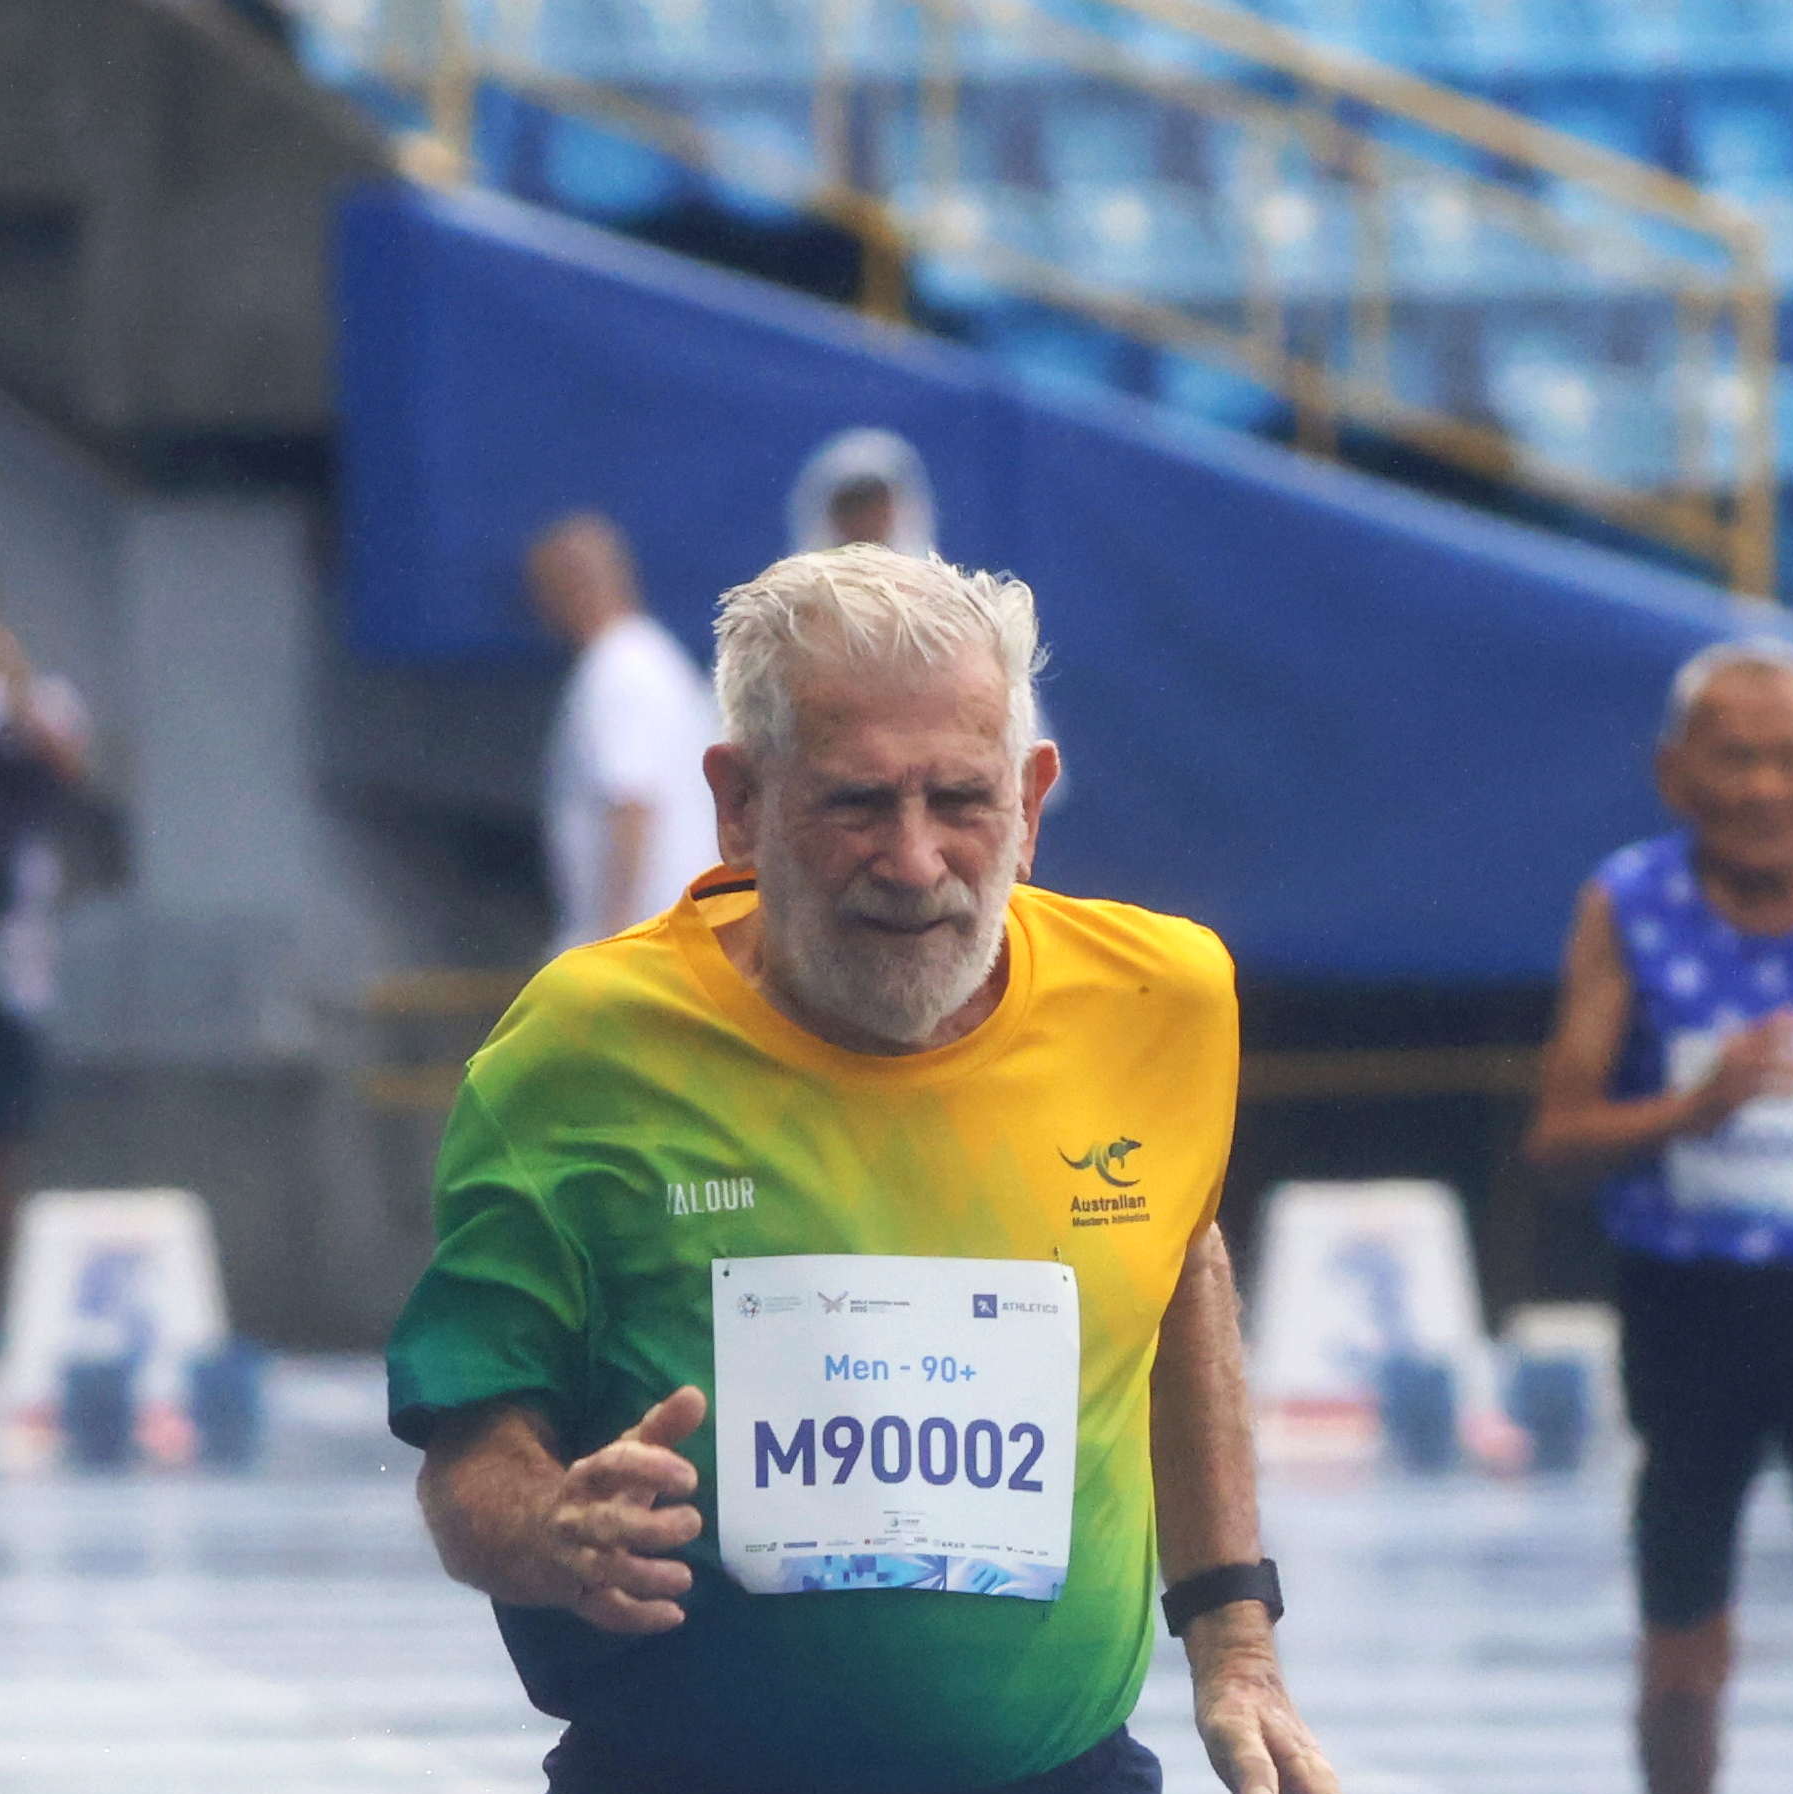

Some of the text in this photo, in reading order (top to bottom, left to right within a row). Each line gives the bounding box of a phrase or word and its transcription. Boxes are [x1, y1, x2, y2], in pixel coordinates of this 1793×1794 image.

[1070, 1194, 1146, 1212] Australian
[825, 1353, 889, 1382] Men
[921, 1355, 977, 1384] 90+
[754, 1415, 1045, 1493] M90002
